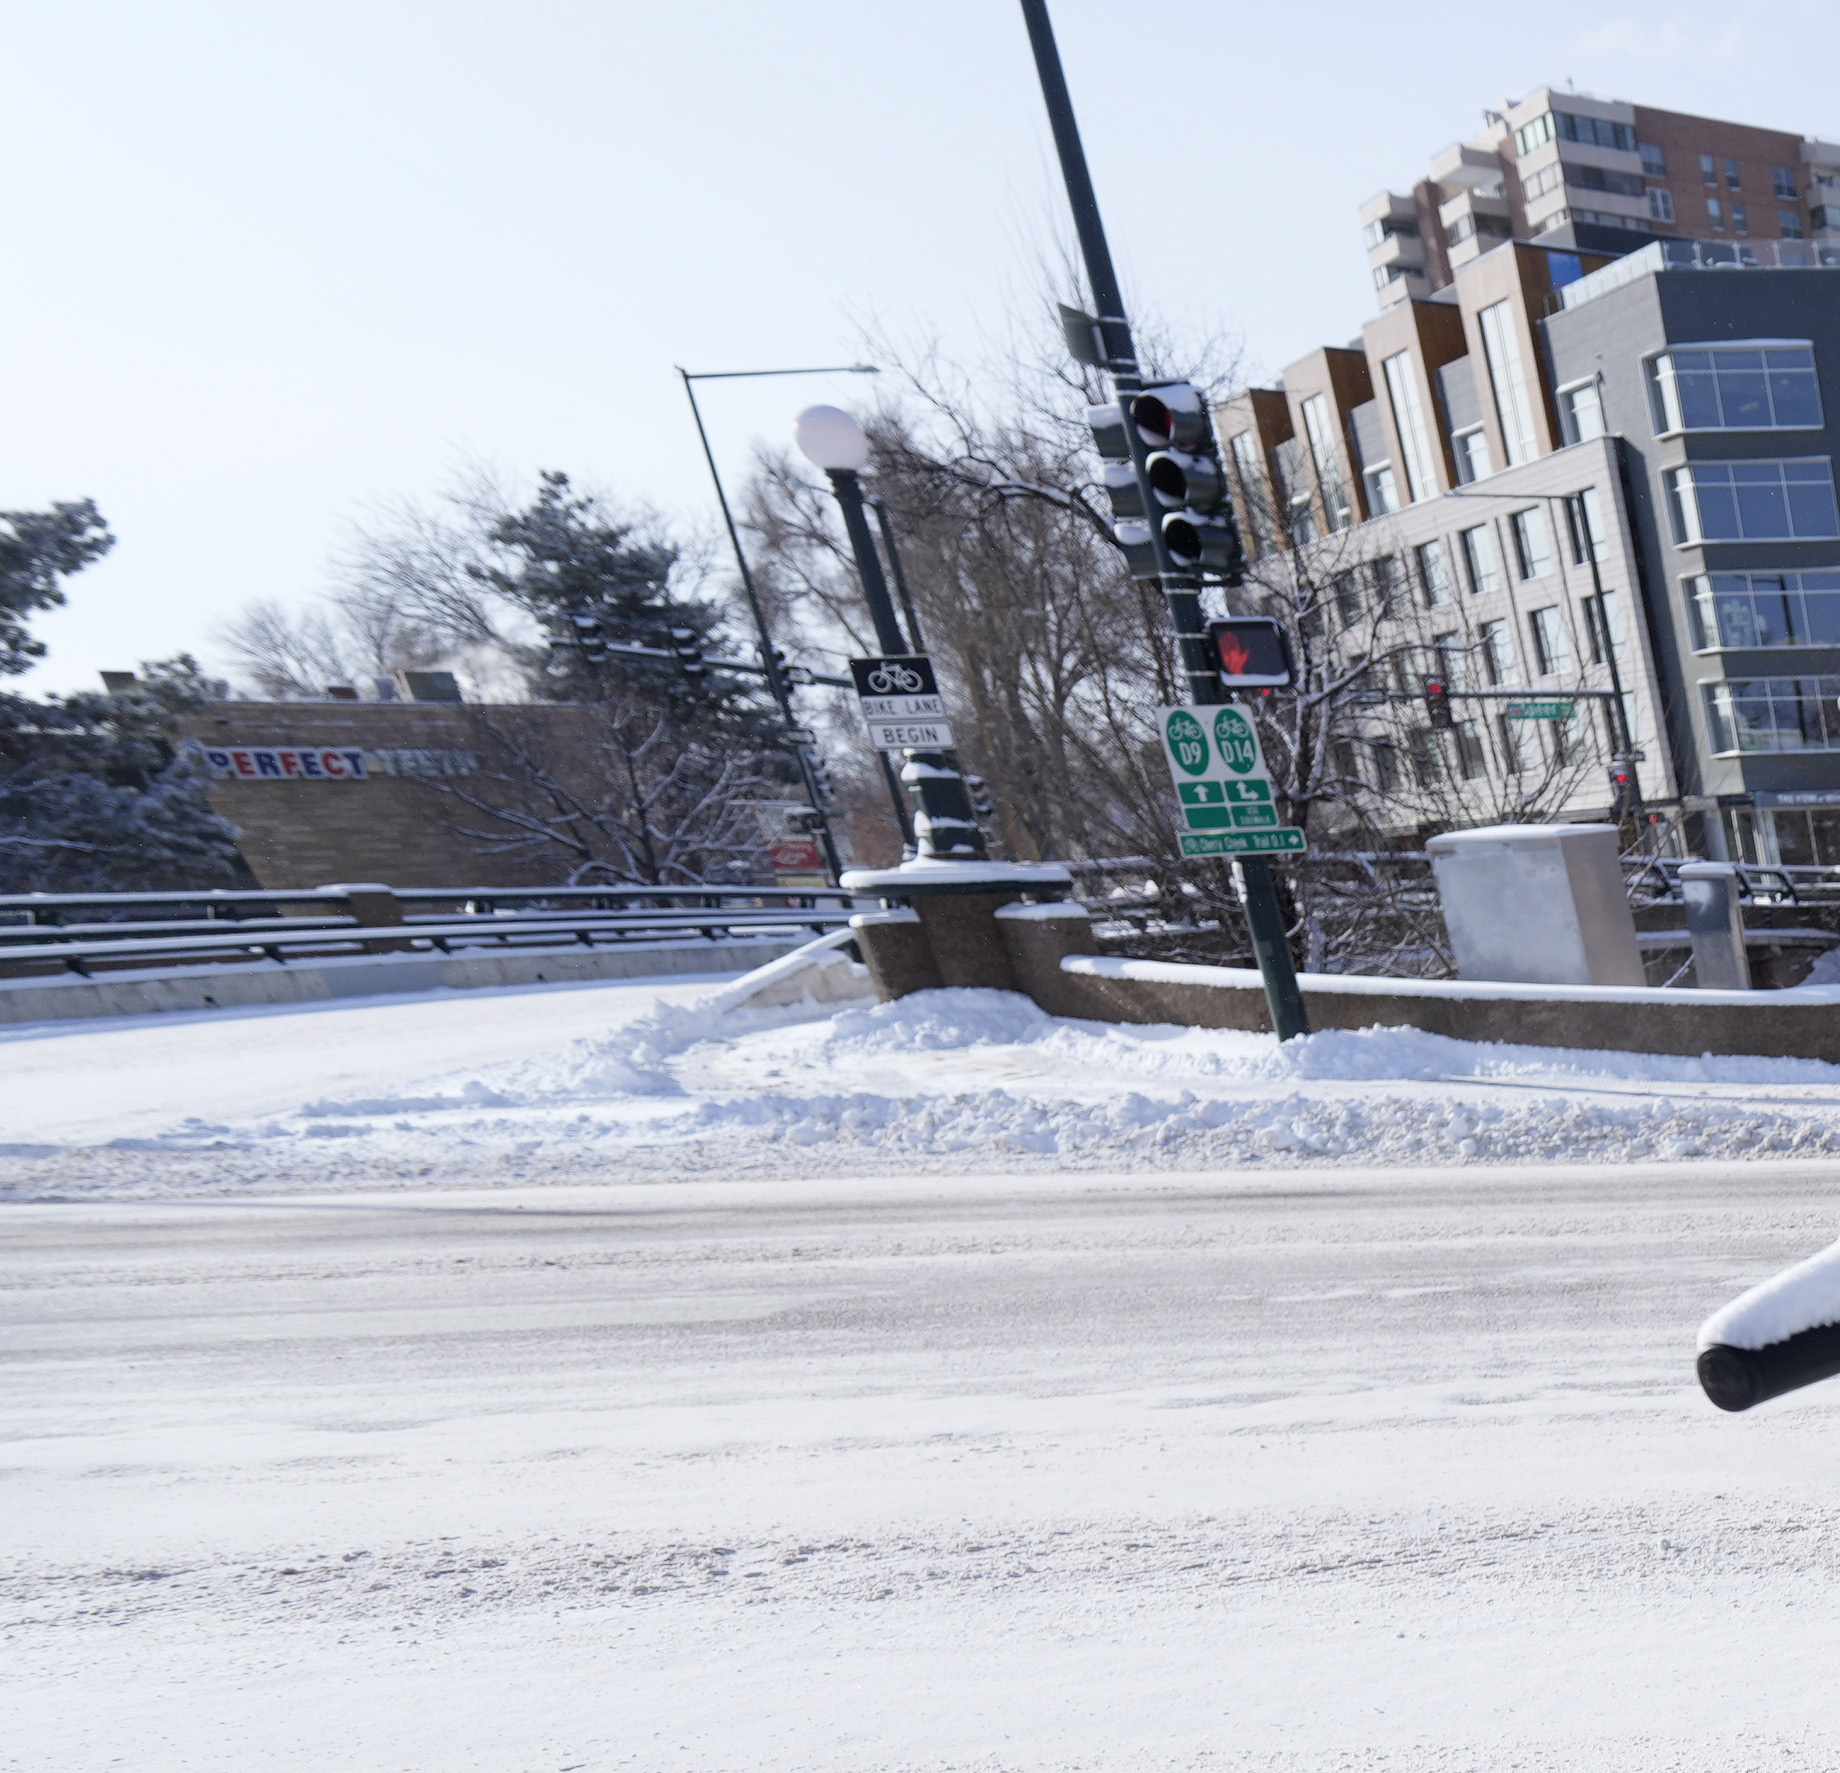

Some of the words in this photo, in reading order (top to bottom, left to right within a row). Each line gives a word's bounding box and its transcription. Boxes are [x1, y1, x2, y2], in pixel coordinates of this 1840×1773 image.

[866, 700, 896, 715] BIKE
[906, 700, 943, 715] LANE
[883, 726, 939, 744] BEGIN
[1179, 741, 1202, 766] D9
[1220, 739, 1255, 764] D14
[208, 752, 364, 777] PERFECT
